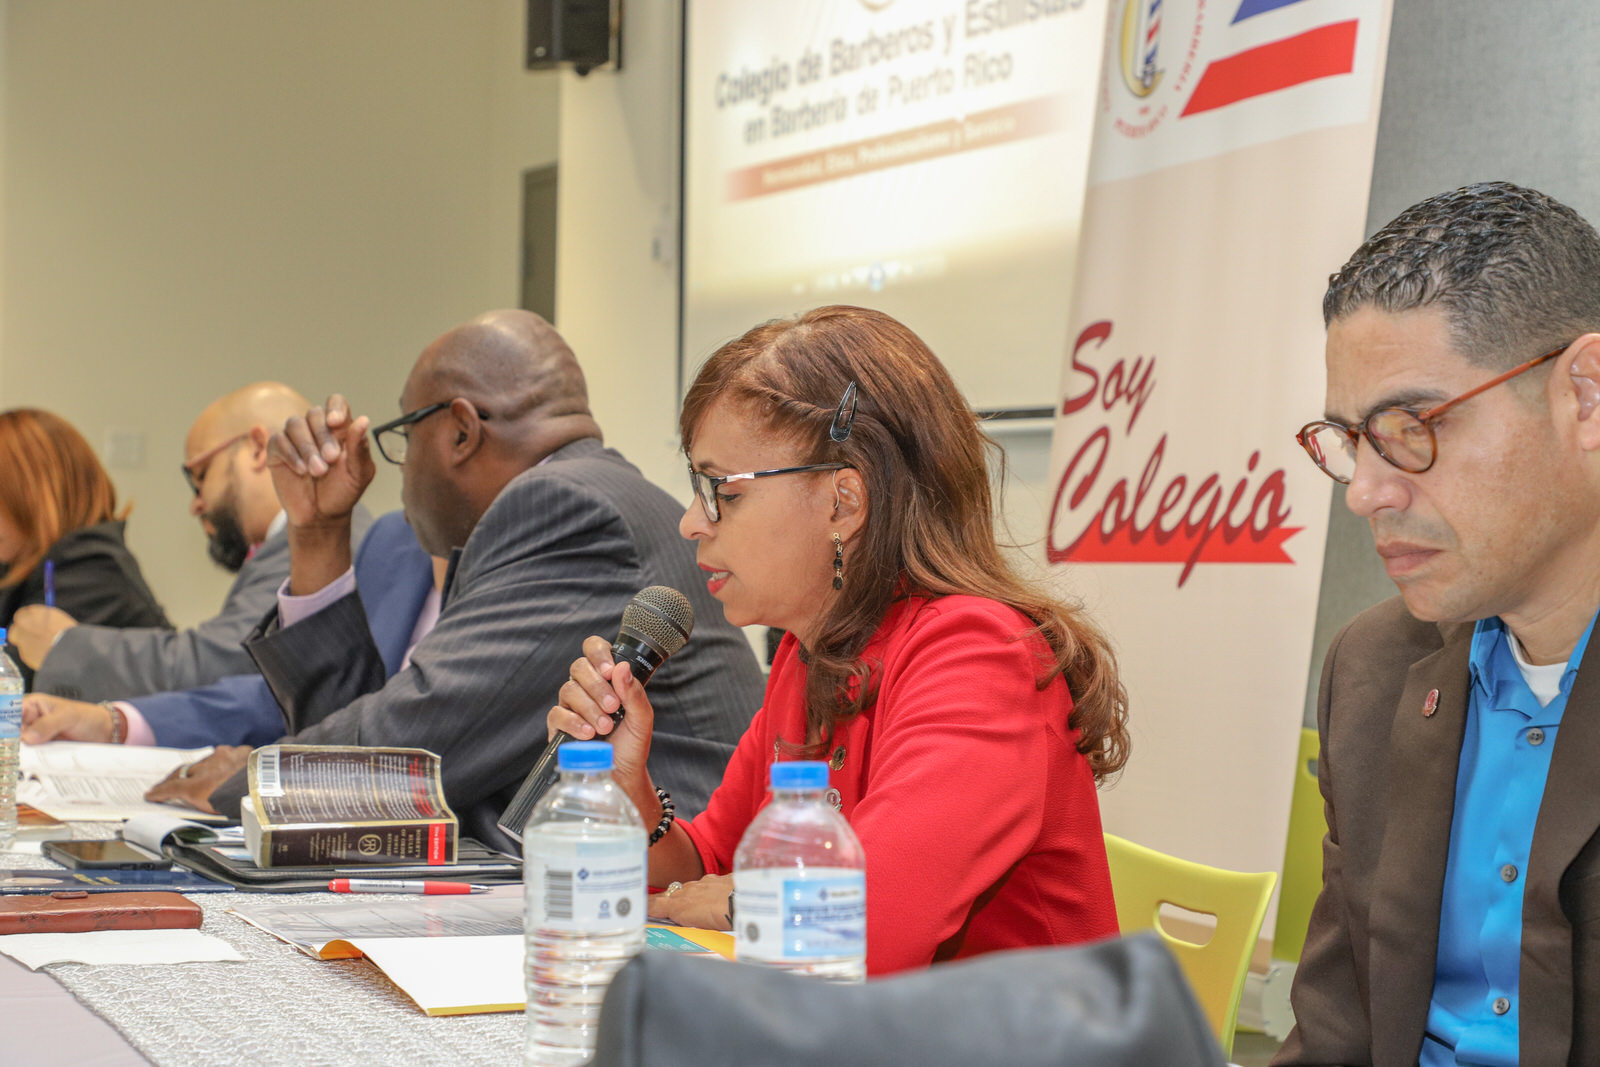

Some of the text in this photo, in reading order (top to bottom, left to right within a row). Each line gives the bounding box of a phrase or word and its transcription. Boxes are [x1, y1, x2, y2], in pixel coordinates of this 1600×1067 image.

[715, 54, 791, 108] Colegio
[797, 46, 821, 85] de
[830, 21, 934, 76] Barberos
[942, 13, 956, 55] y
[743, 117, 764, 145] en
[857, 84, 880, 116] de
[887, 66, 954, 106] Puerto
[963, 50, 1014, 88] Rico
[1062, 320, 1157, 437] Soy
[1046, 425, 1293, 590] Colegio
